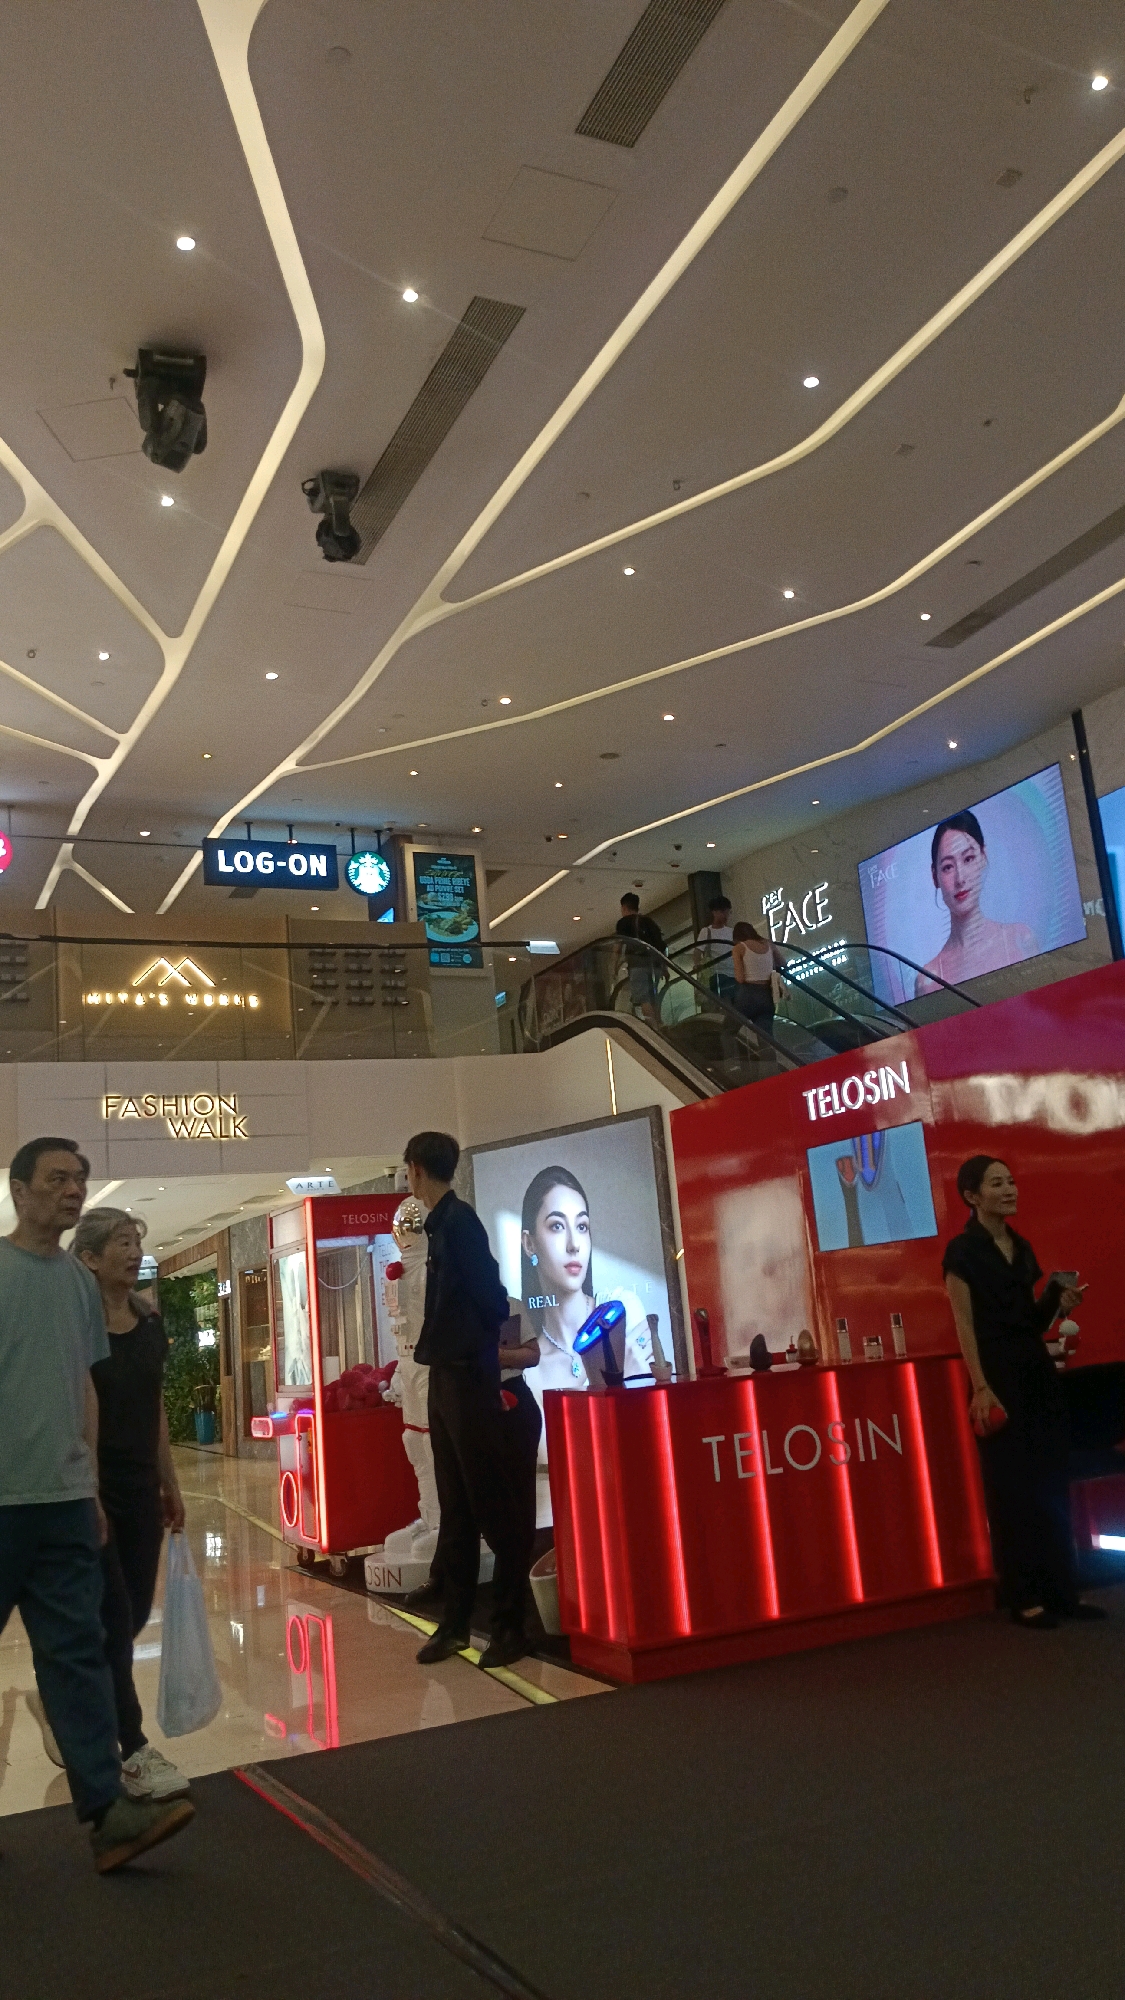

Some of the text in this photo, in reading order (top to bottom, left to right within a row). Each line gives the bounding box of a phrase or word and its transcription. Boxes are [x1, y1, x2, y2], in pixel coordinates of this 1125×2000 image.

[218, 849, 327, 877] LOG-ON
[870, 862, 899, 889] FACE
[768, 882, 832, 944] FACE
[802, 1060, 911, 1121] TELOSIN
[103, 1094, 239, 1119] FASHION
[167, 1115, 249, 1139] WALK
[295, 1180, 334, 1189] ARTE
[342, 1213, 389, 1225] TELOSIN
[528, 1294, 560, 1309] REAL
[702, 1413, 903, 1483] TELOSIN
